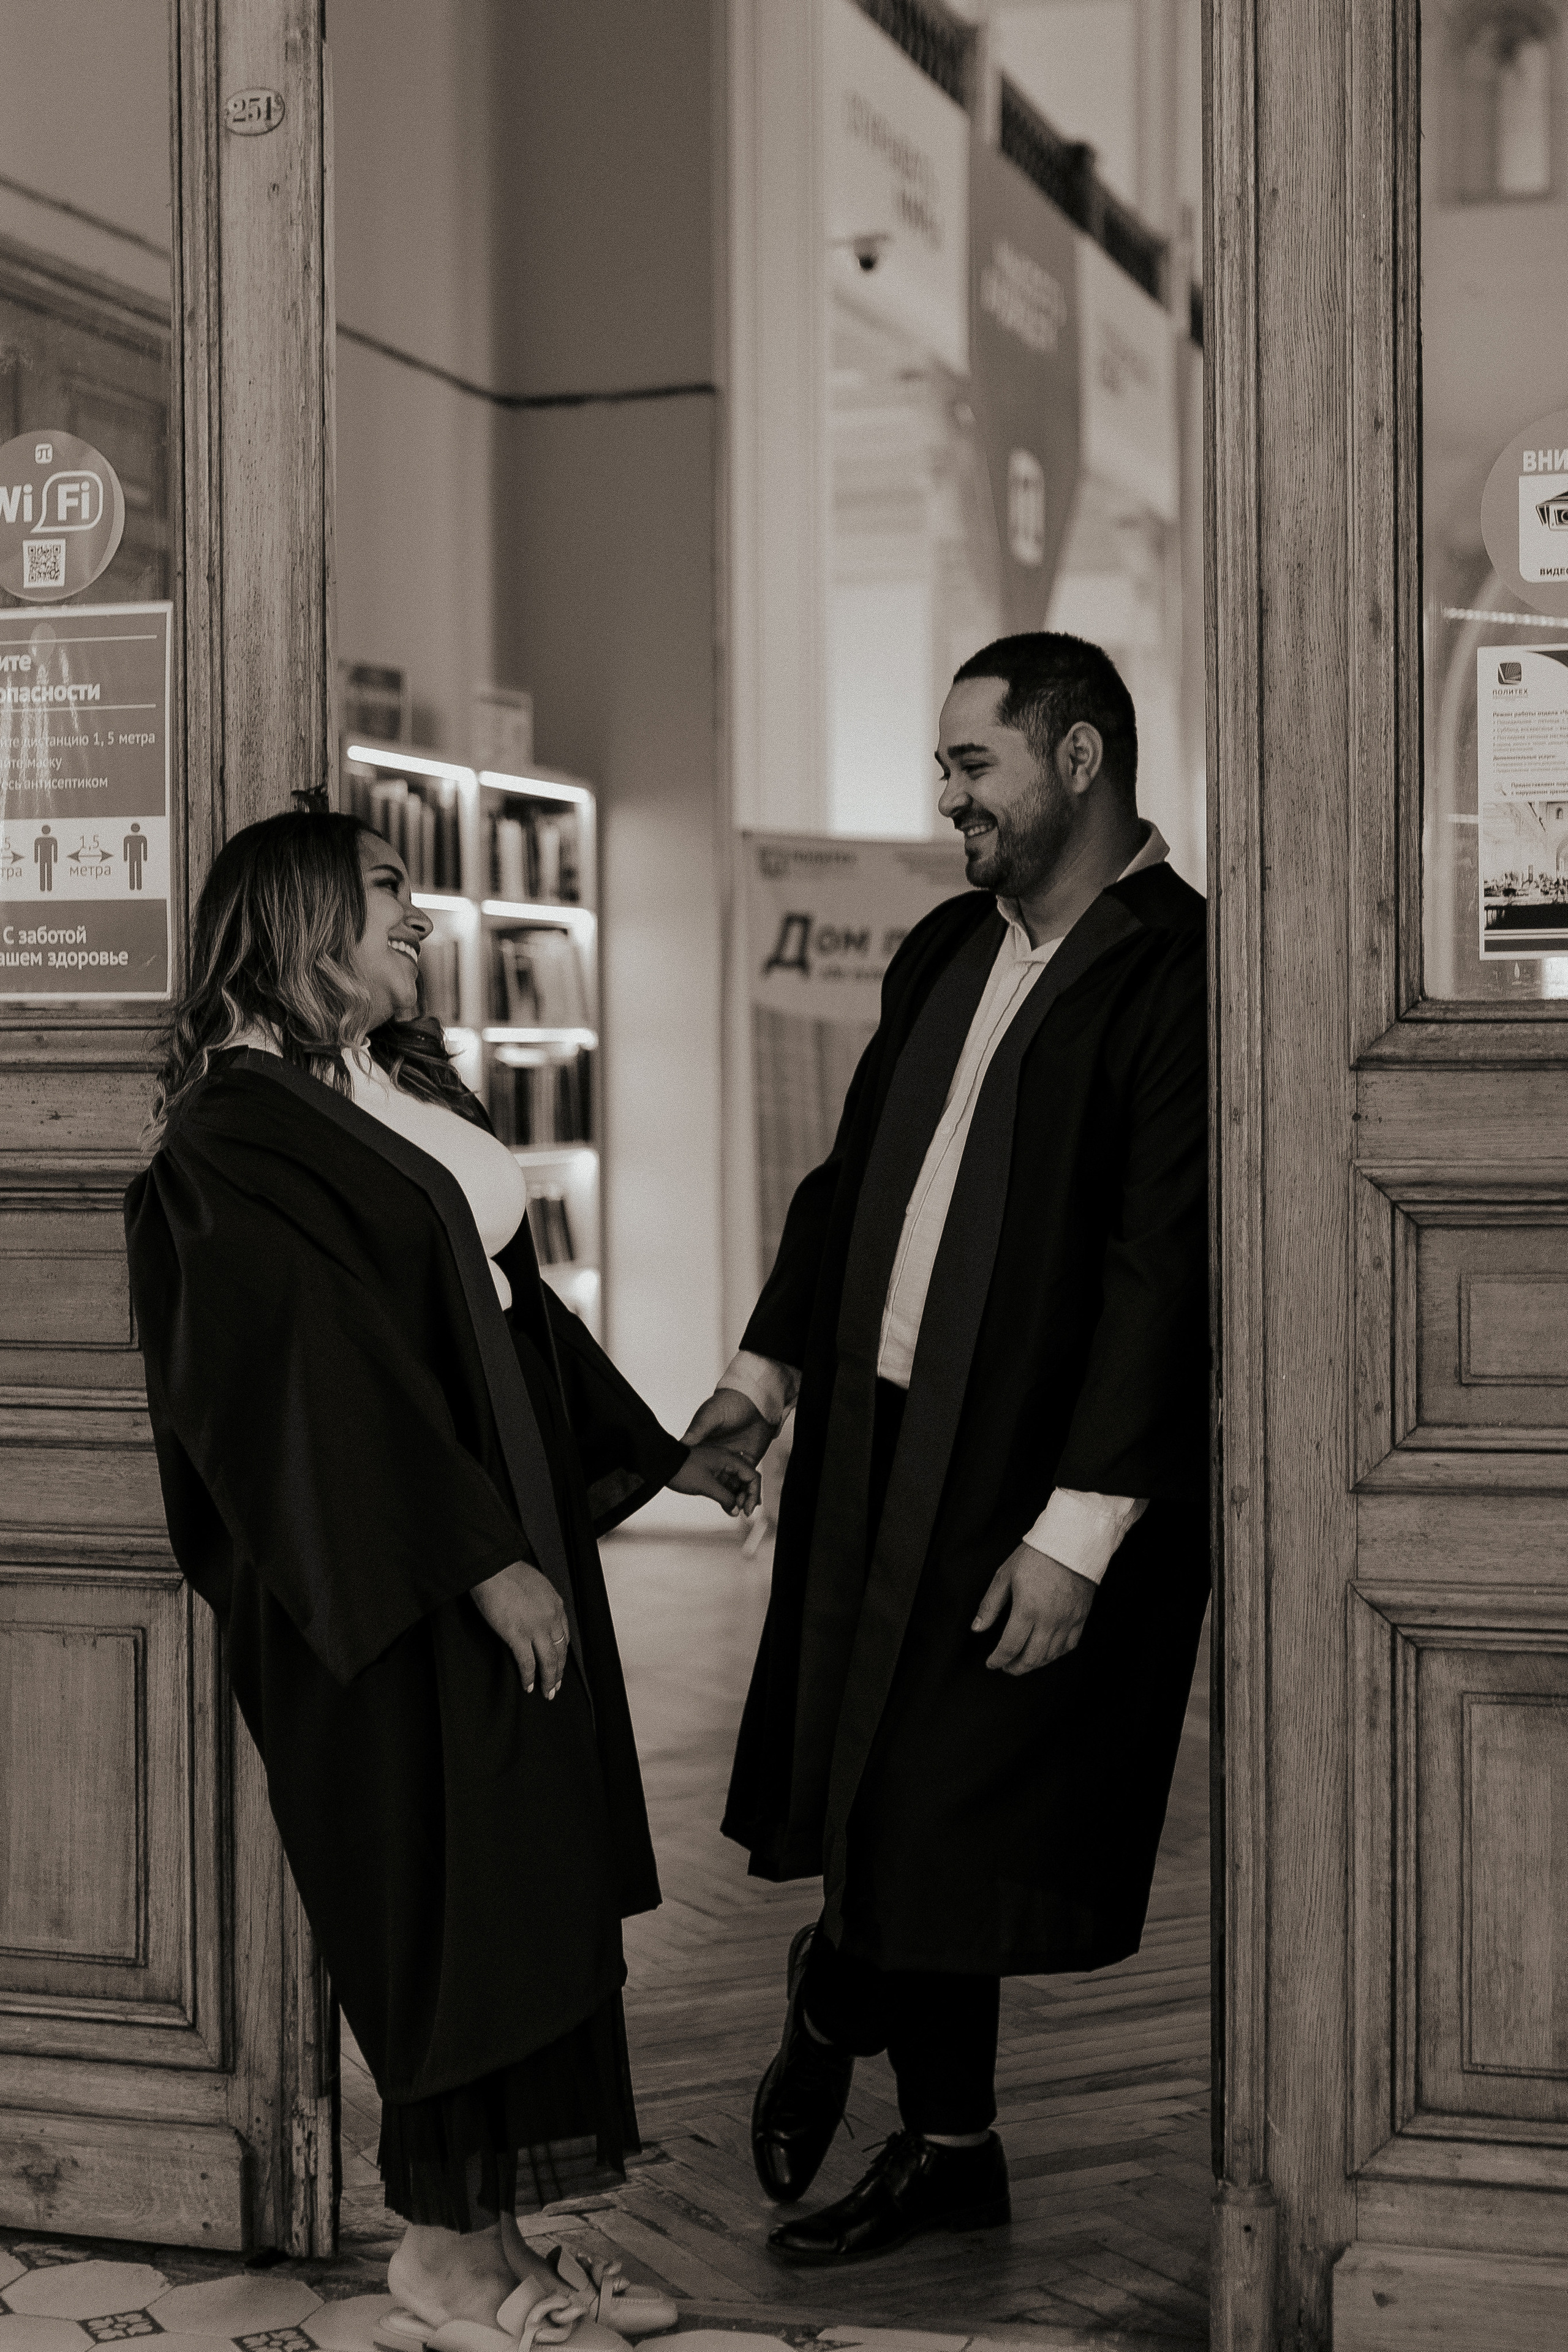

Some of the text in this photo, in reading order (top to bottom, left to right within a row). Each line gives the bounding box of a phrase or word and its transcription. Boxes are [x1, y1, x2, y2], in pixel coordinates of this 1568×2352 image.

[232, 96, 271, 122] 251
[1523, 448, 1568, 472] ВНИ
[58, 481, 90, 521] Fi
[119, 733, 155, 747] метра
[24, 777, 108, 791] антисептиком
[80, 835, 100, 850] 1,5
[69, 864, 111, 879] метра
[3, 925, 86, 944] С заботой
[48, 951, 129, 970] здоровье
